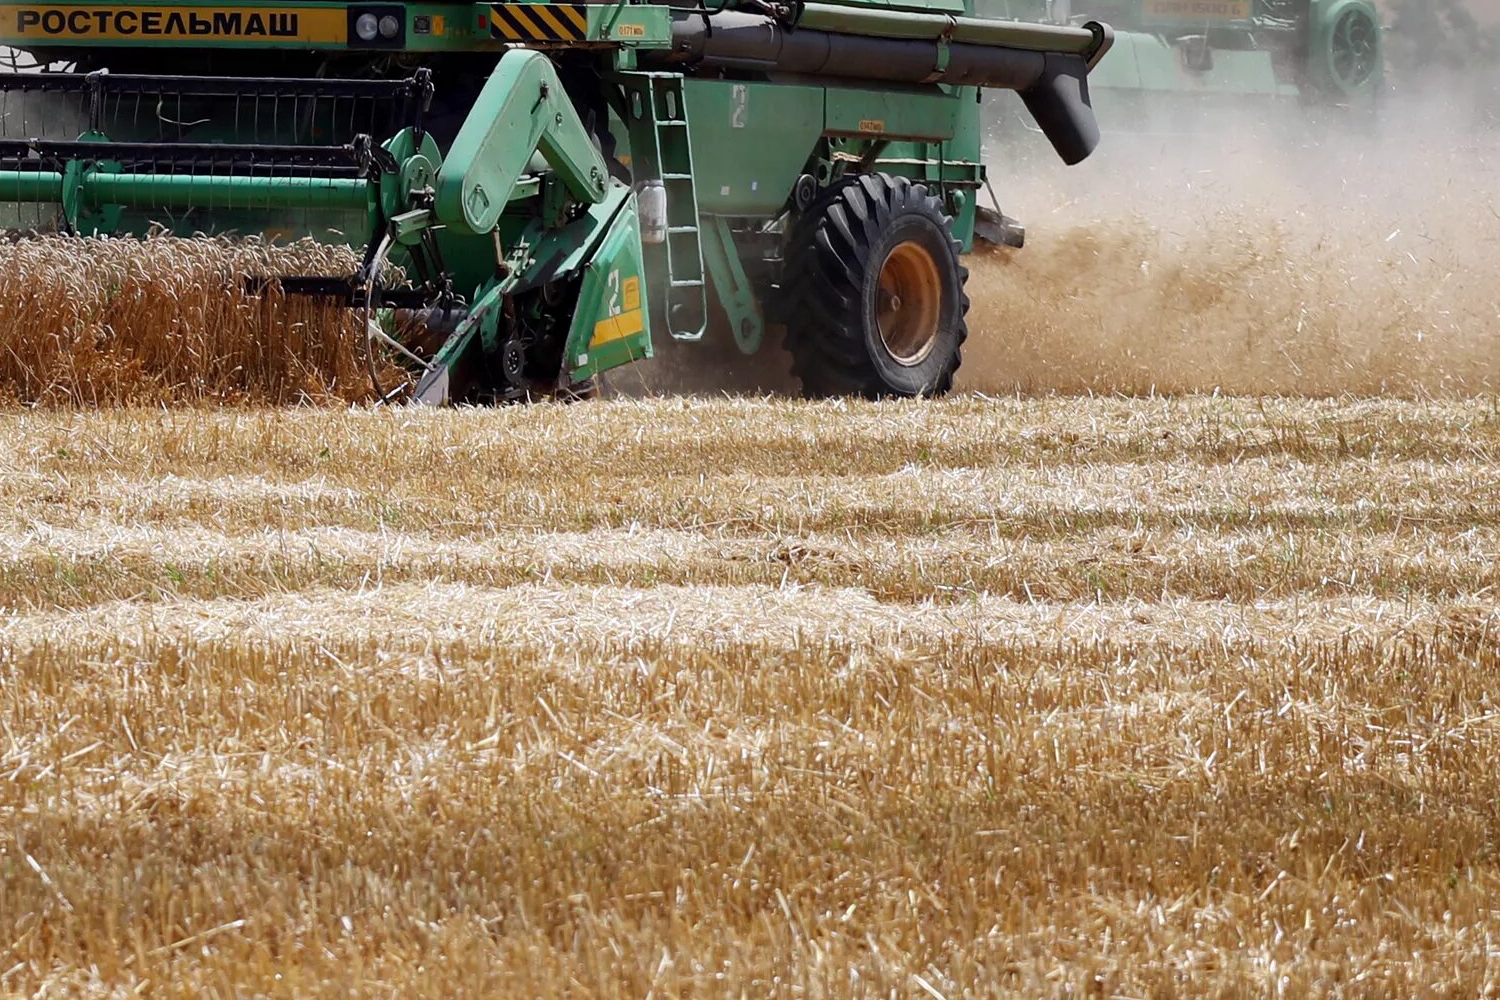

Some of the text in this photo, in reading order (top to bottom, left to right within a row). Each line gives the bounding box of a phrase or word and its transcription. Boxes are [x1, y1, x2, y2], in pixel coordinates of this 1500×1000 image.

[16, 9, 299, 37] РОСТСЕЛЬМАШ
[732, 84, 746, 128] 2
[608, 268, 621, 317] 2
